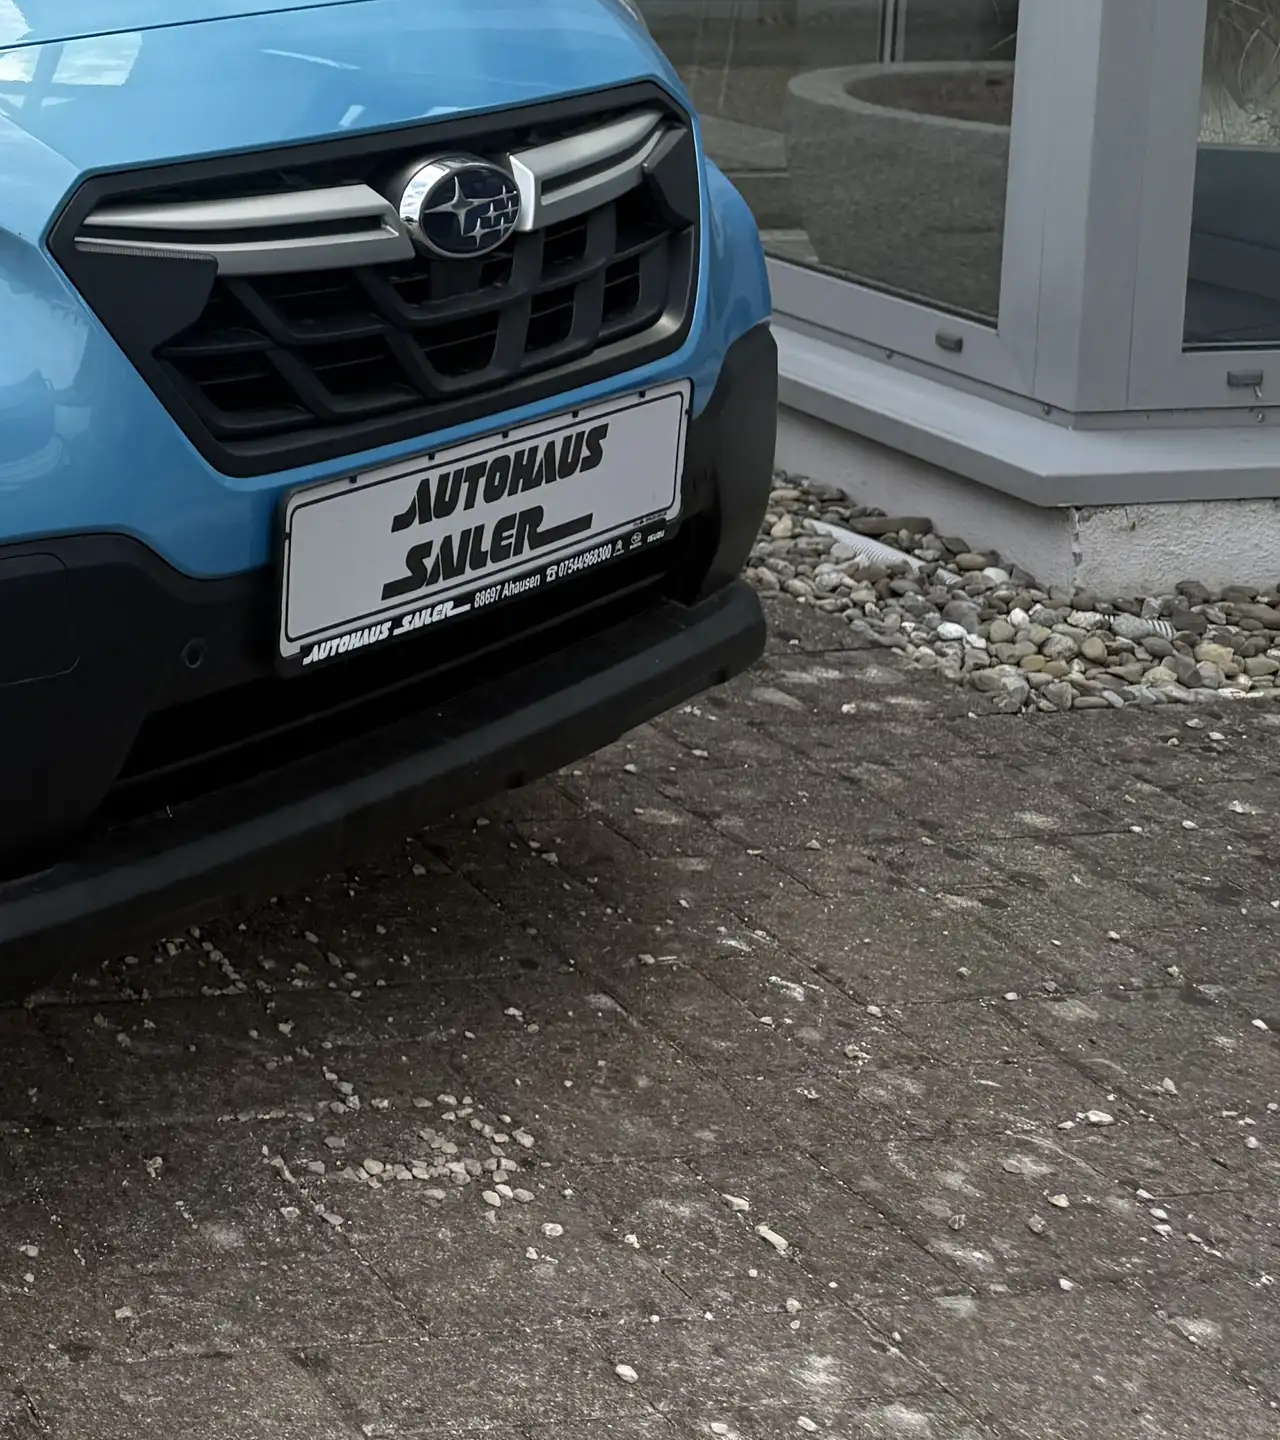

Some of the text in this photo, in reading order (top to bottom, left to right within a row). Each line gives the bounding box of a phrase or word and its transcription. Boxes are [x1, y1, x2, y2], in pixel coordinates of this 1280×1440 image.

[391, 423, 608, 533] AUTOHAUS
[302, 543, 613, 666] AUTOHAUS SAILER 88697 Ahausen 07544/968300
[381, 504, 593, 601] SAILER
